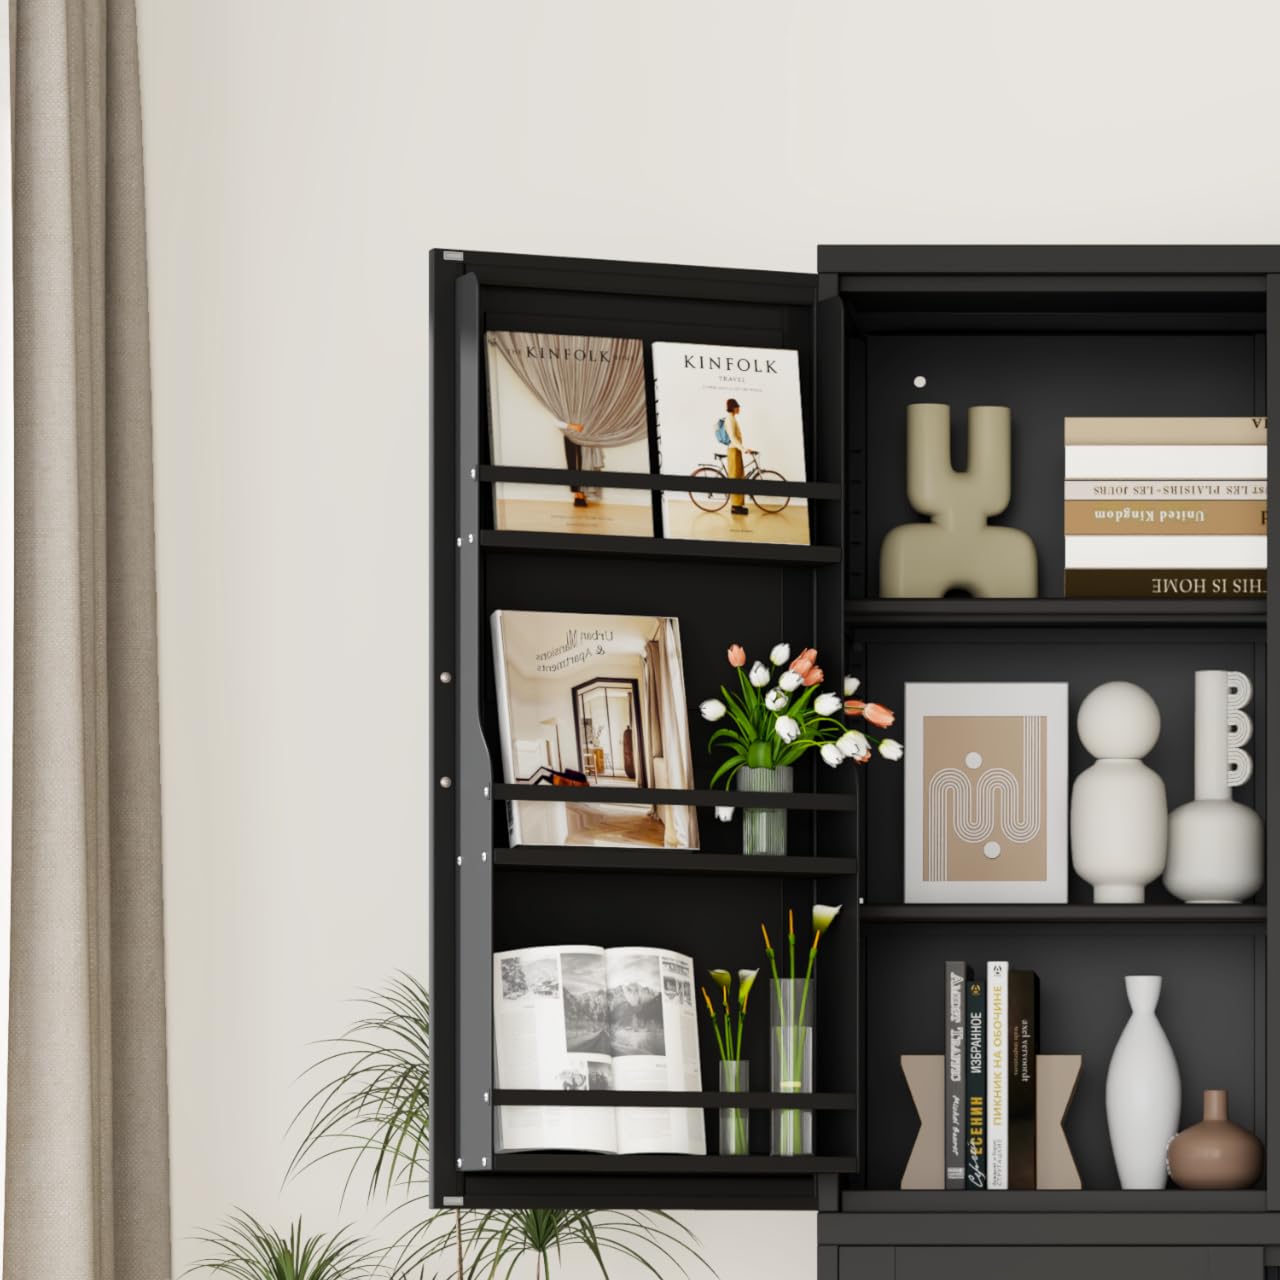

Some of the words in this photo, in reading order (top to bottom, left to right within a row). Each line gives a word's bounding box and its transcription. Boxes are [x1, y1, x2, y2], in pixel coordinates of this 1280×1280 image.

[527, 345, 610, 363] KINFOLK
[684, 355, 777, 373] KINFOLK
[1093, 486, 1129, 495] JOURS
[1133, 486, 1153, 494] LES
[1163, 486, 1220, 494] PLAISIRS
[1226, 486, 1248, 494] LES
[1094, 507, 1155, 522] Kingdom
[1160, 510, 1205, 522] United
[1152, 579, 1206, 593] HOME
[1212, 579, 1227, 593] IS
[1232, 579, 1266, 593] HIS
[993, 986, 1002, 1047] ОБОЧИНЕ
[1021, 1019, 1030, 1037] axel
[971, 1012, 982, 1073] ИЗБРАННОЕ
[994, 1051, 1002, 1068] НА
[1021, 1040, 1030, 1082] vervoordt
[994, 1072, 1002, 1126] ПИКНИК
[971, 1097, 983, 1154] ЕСЕНИН
